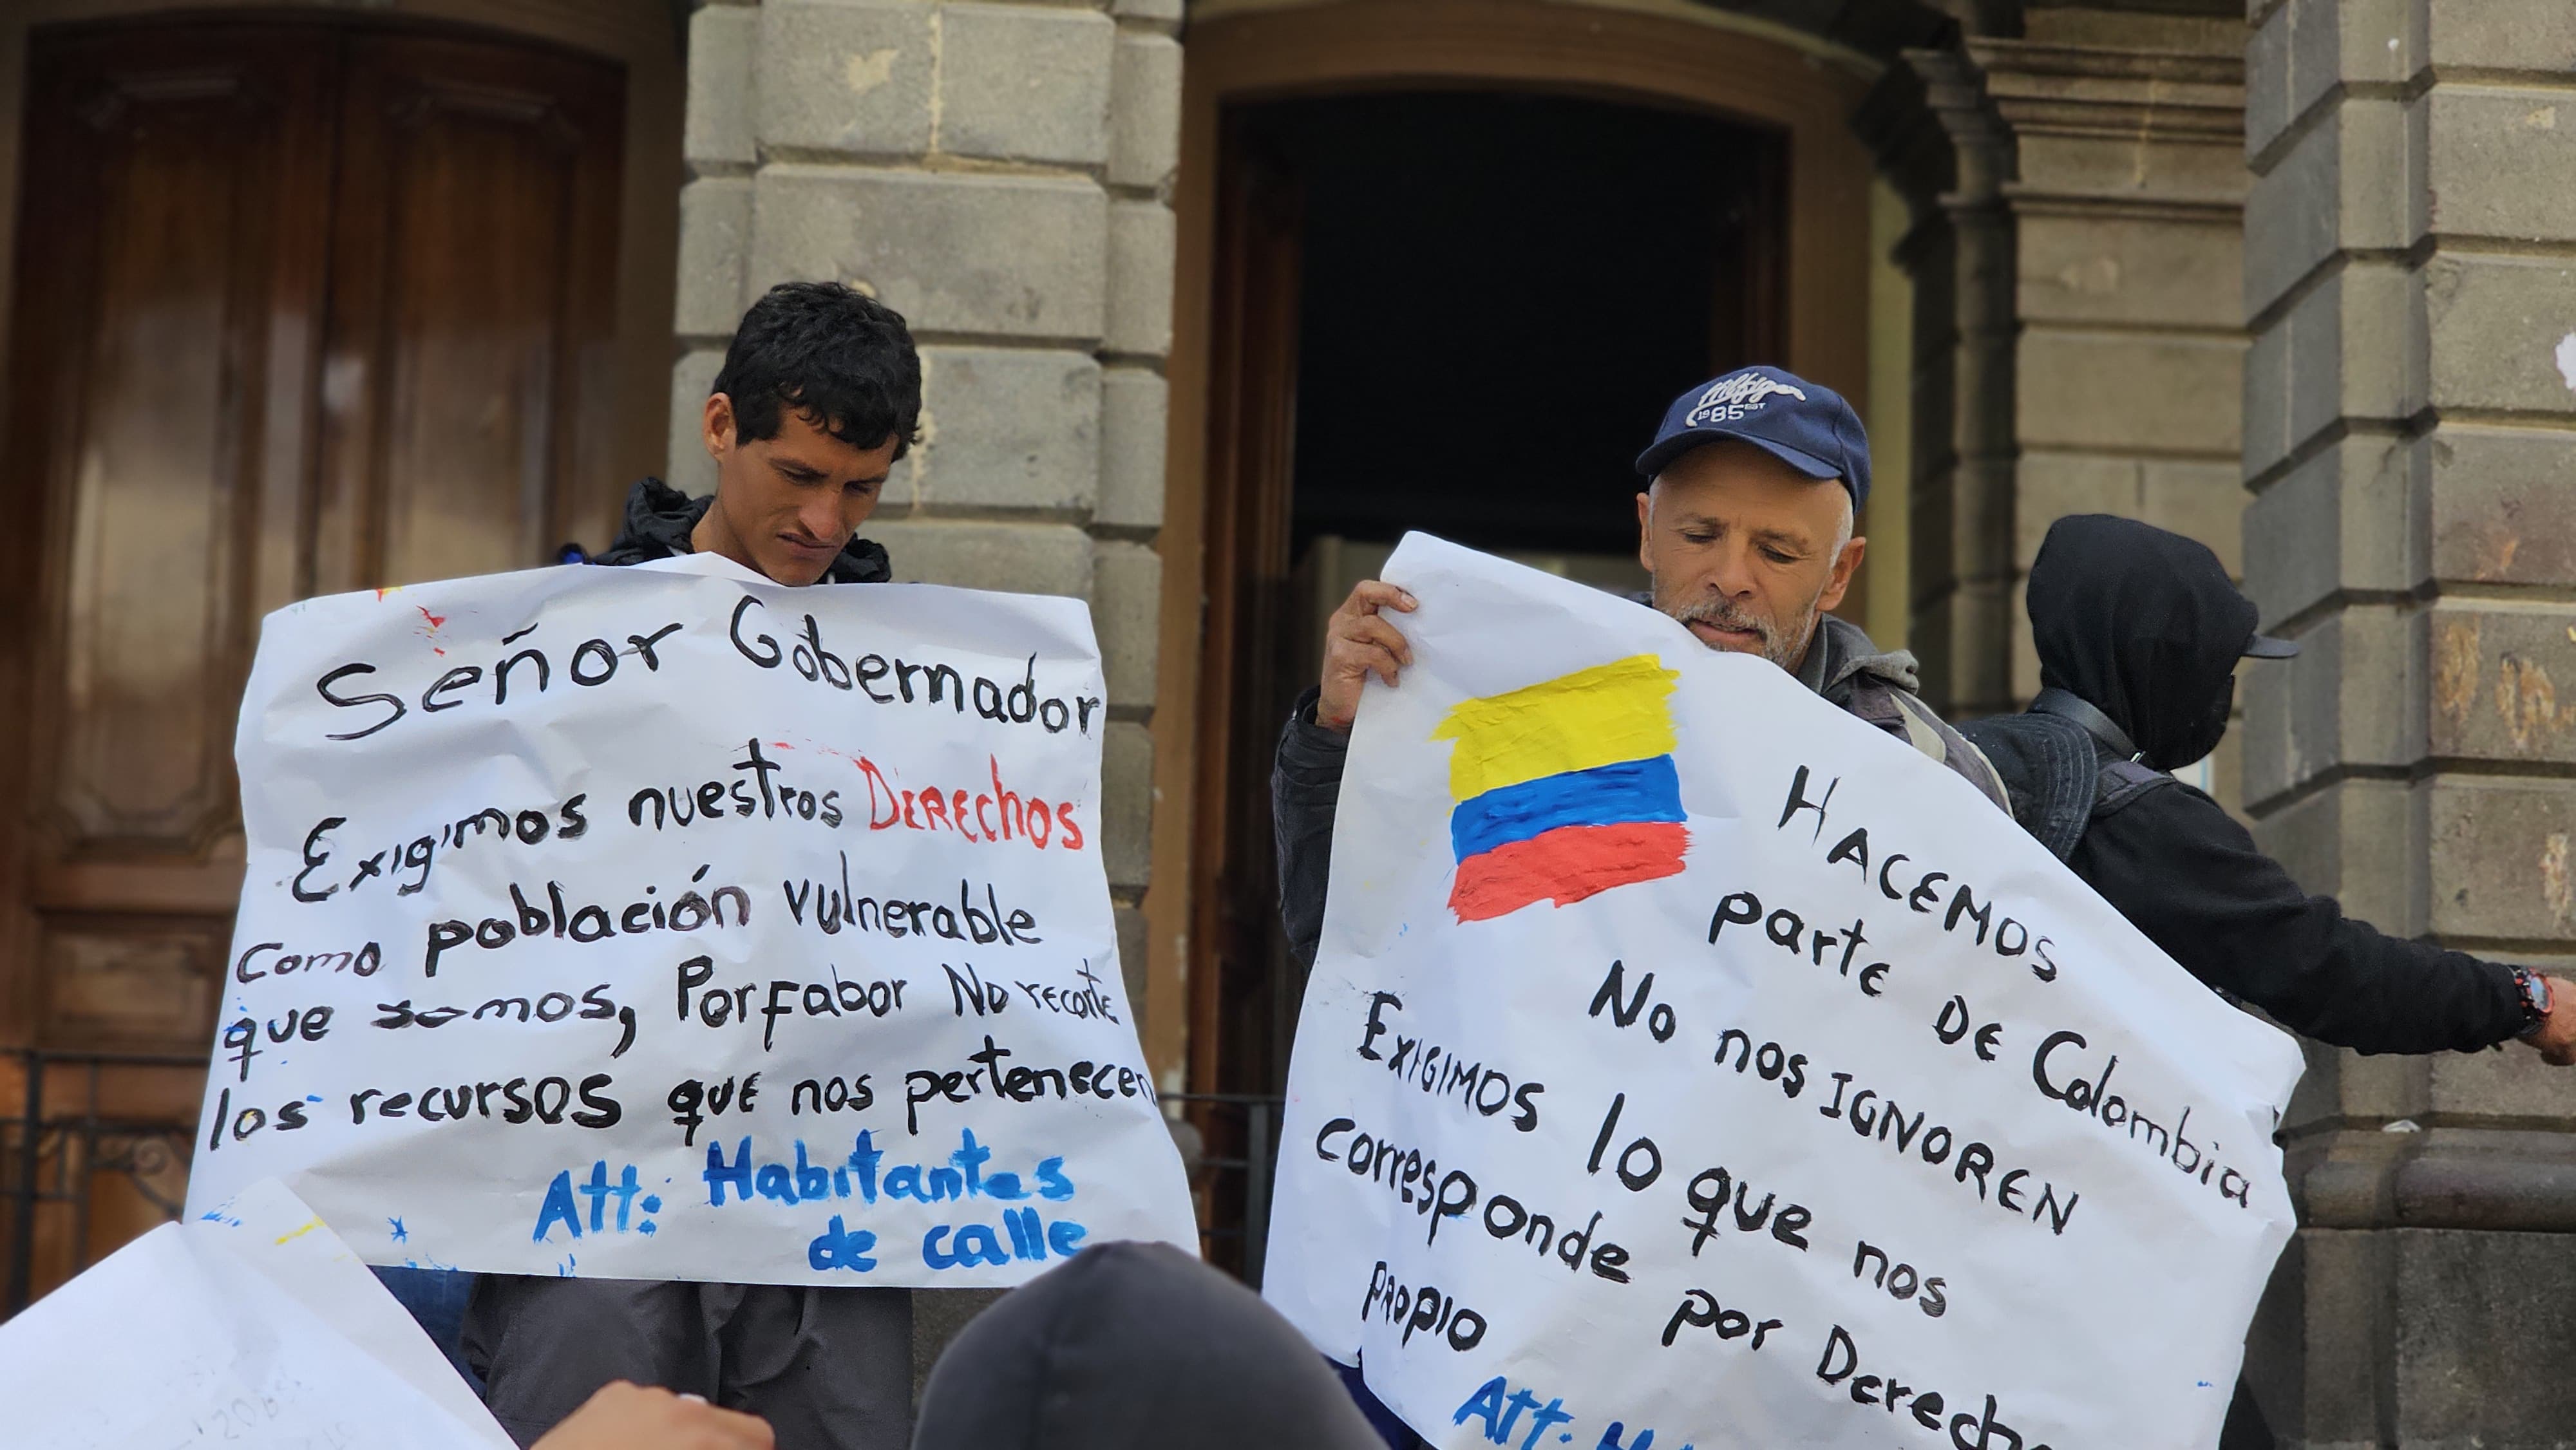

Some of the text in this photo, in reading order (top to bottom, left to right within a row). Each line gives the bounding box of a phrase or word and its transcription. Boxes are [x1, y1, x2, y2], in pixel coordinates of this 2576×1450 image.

[1697, 404, 1745, 424] 1985
[316, 594, 1100, 740] Señor Gobernador
[292, 793, 587, 903] Exigimos
[628, 738, 843, 831] nuestros
[1777, 764, 2057, 983] HACEMOS
[426, 863, 751, 978] población
[783, 851, 1042, 946] vulnerable
[210, 1088, 308, 1151] los
[350, 1073, 623, 1129] recursos
[791, 1073, 874, 1115] nos
[905, 1034, 1157, 1136] pertenecen
[223, 1006, 334, 1082] que
[942, 963, 1009, 1017] No
[1588, 960, 2079, 1236] No nos IGNOREN
[2032, 1031, 2250, 1209] Colombia
[532, 1127, 1075, 1243] Att: Habitantes
[808, 1205, 1089, 1273] de calle
[1587, 1093, 1662, 1192] lo
[1682, 1166, 1812, 1257] que
[1853, 1241, 1946, 1317] nos
[1316, 1118, 1631, 1284] corresponde
[1816, 1324, 2053, 1450] Derech
